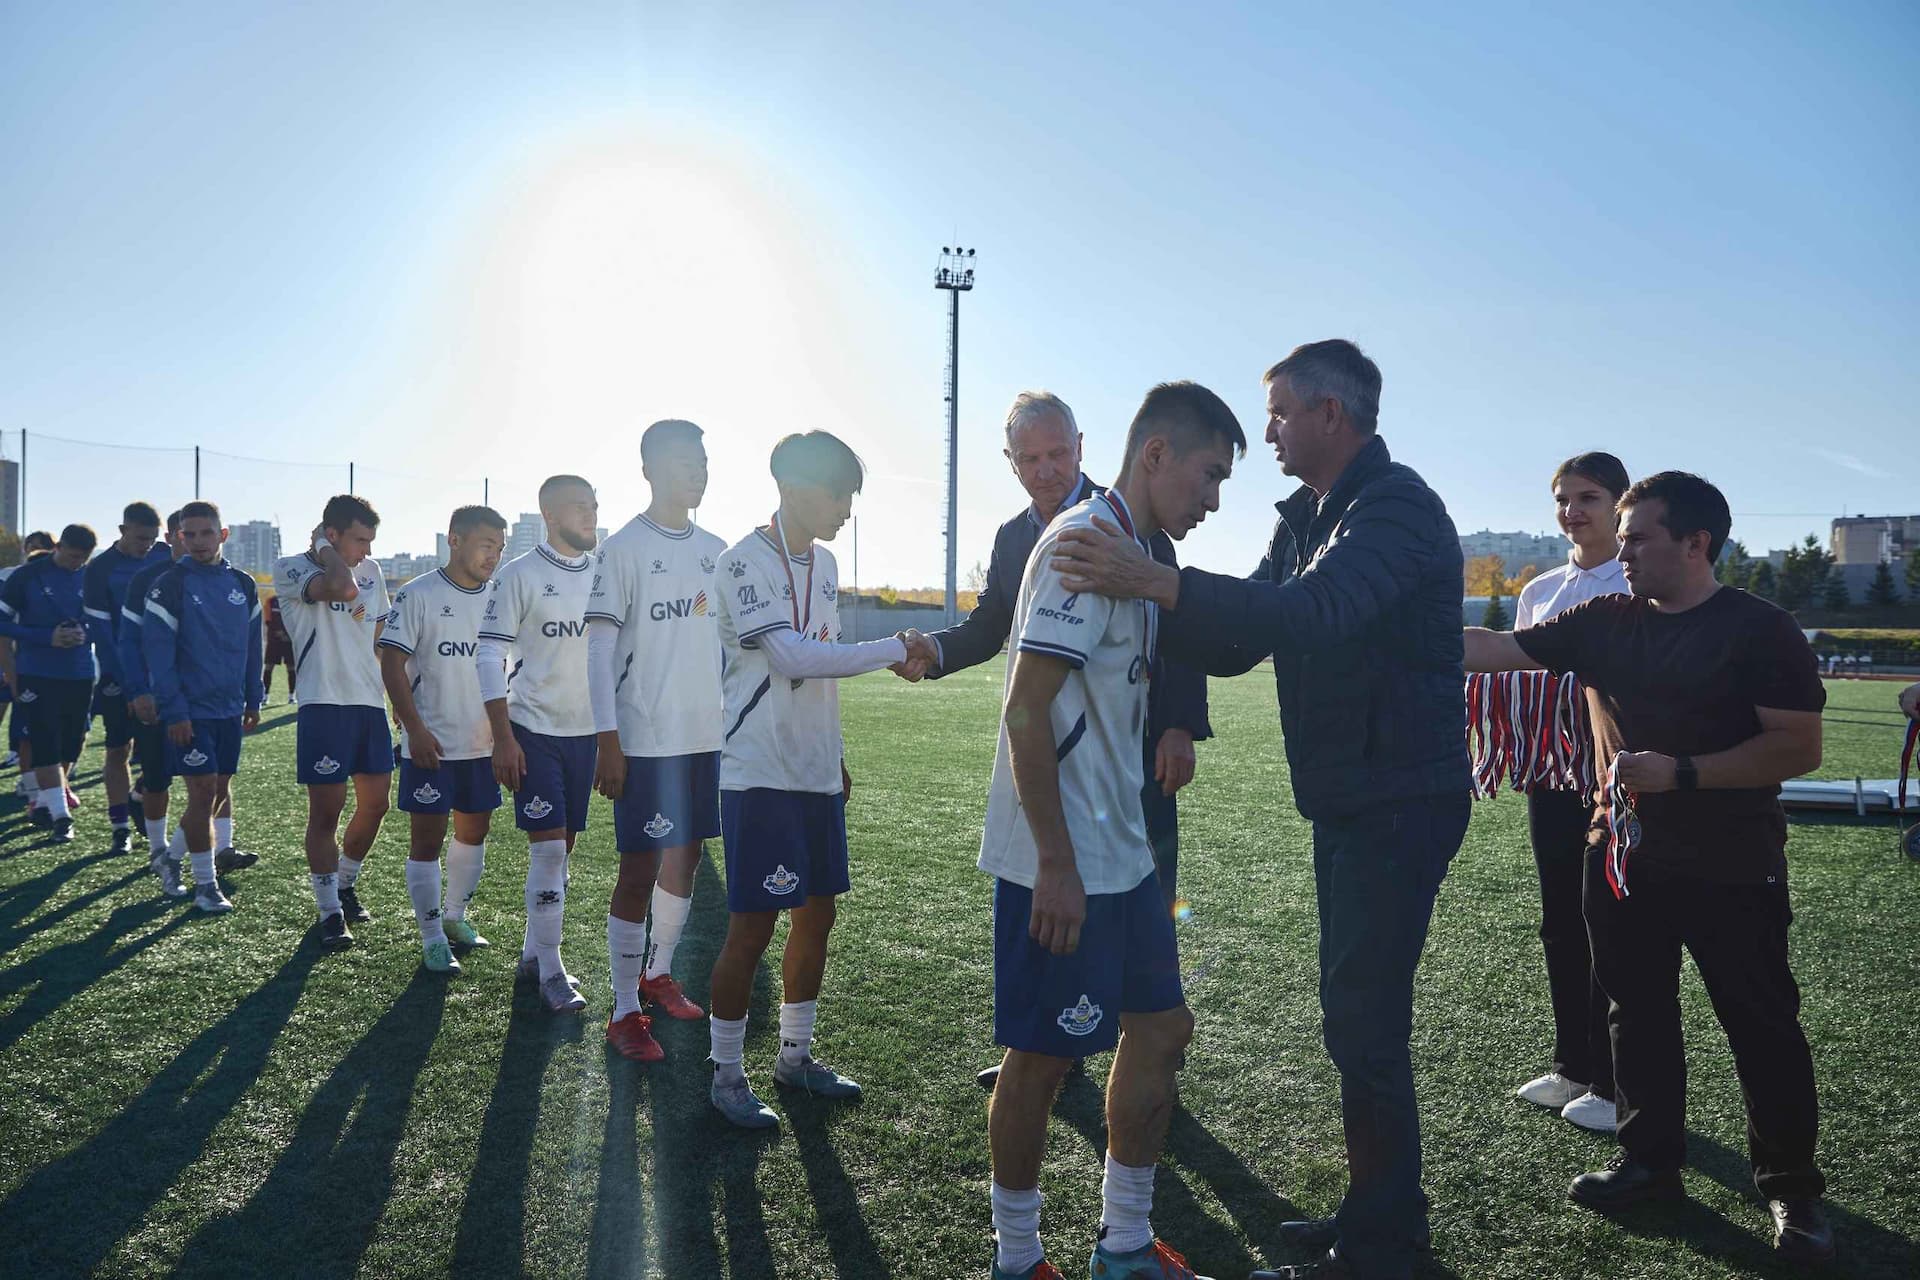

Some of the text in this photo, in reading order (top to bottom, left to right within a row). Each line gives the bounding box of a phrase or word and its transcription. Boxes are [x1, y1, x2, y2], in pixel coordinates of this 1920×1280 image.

[649, 598, 693, 622] GNV
[739, 600, 771, 617] ПОСТЕР
[1036, 607, 1084, 626] ПОСТЕР
[541, 620, 587, 638] GNV
[437, 640, 478, 657] GNV
